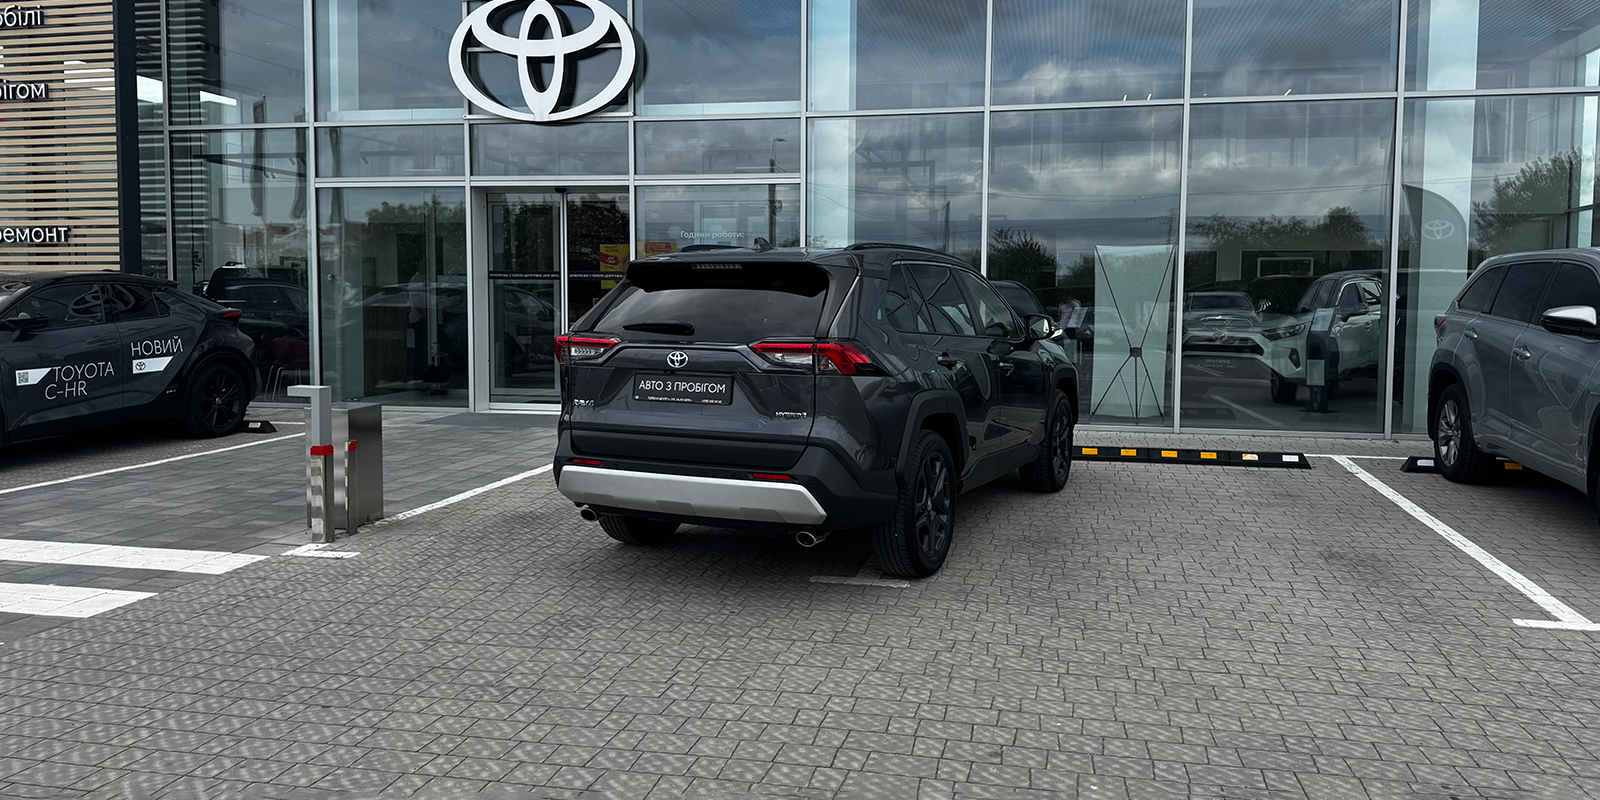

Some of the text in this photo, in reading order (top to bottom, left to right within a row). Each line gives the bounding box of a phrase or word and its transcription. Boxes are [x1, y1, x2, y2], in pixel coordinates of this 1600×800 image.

[0, 4, 41, 27] білі
[0, 79, 46, 100] ігом
[0, 227, 68, 243] емонт
[680, 229, 745, 240] Години роботи:
[130, 335, 184, 357] НОВИЙ
[52, 361, 115, 382] TOYOTA
[44, 380, 88, 400] C-HR
[638, 380, 664, 391] АВТО
[673, 381, 727, 394] ПРОБІГОМ
